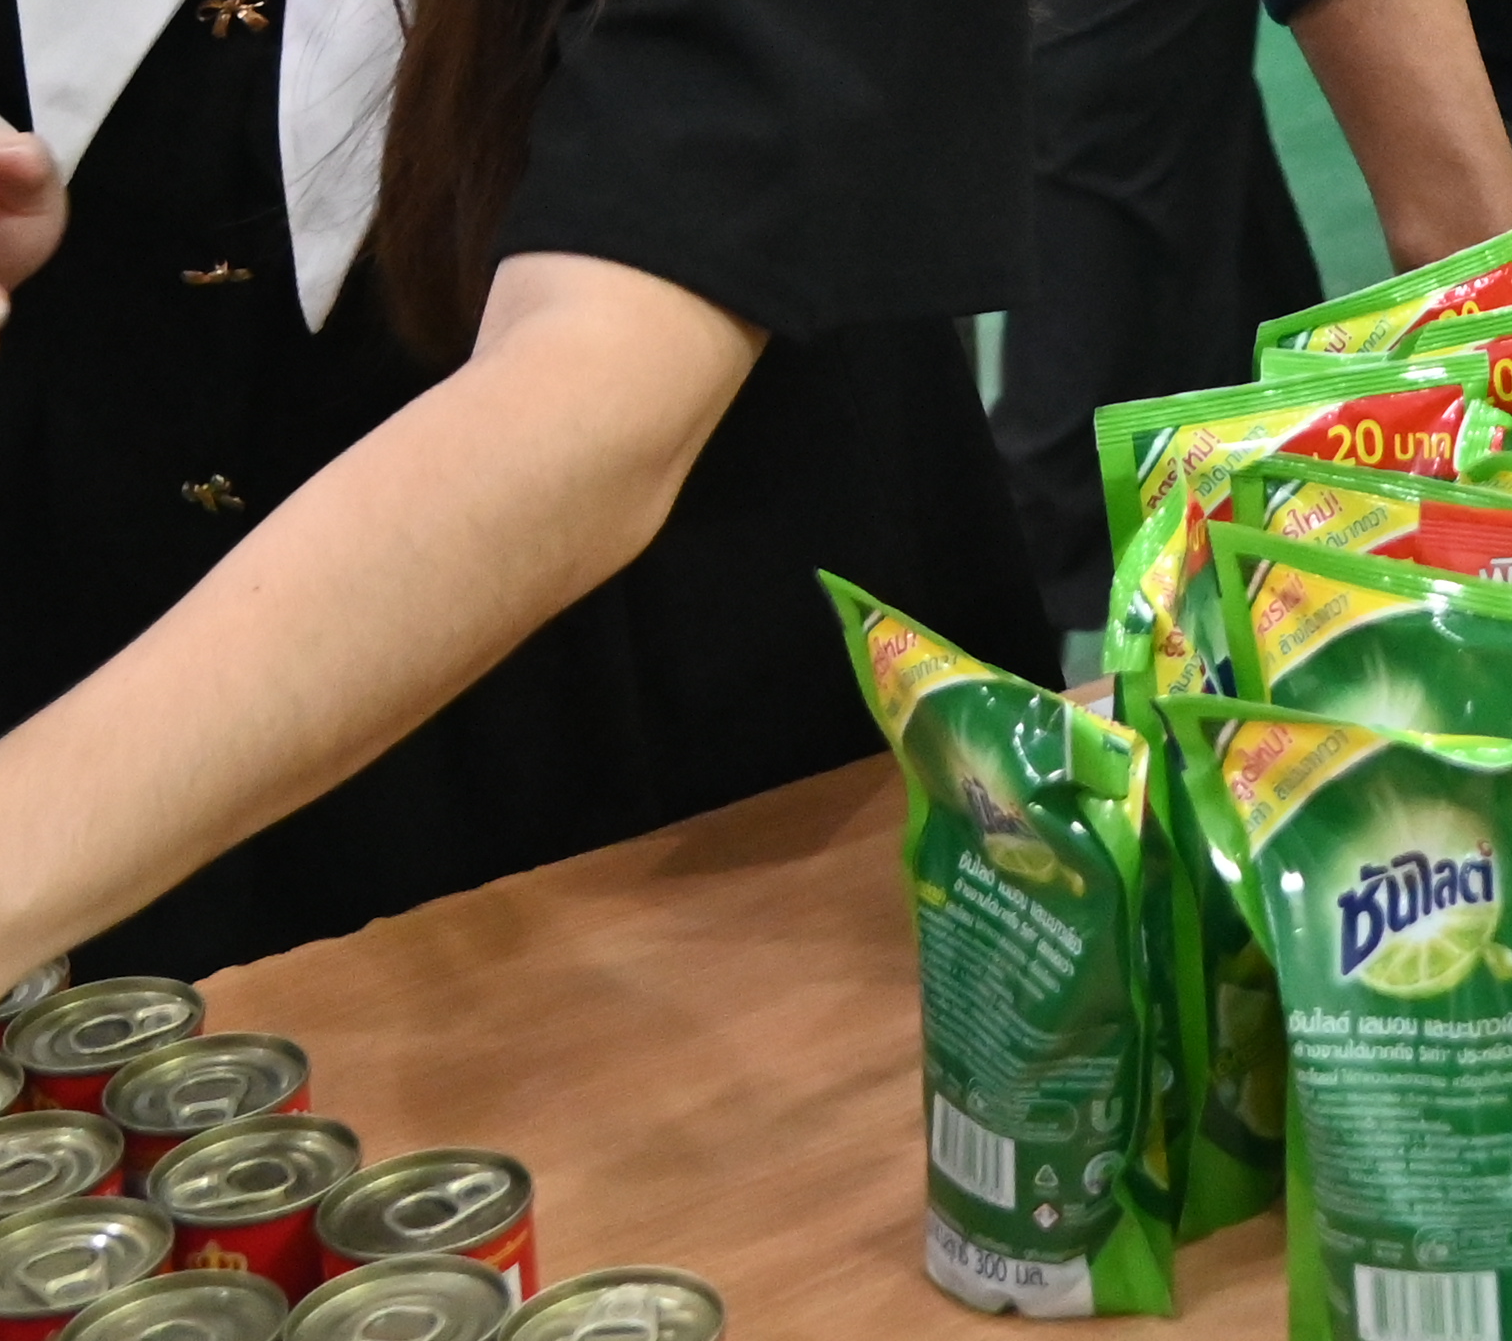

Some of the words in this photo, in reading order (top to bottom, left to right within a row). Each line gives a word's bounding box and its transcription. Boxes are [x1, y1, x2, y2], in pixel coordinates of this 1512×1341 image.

[1327, 419, 1385, 467] 20
[1394, 432, 1452, 461] บาท
[974, 1248, 1008, 1283] 300
